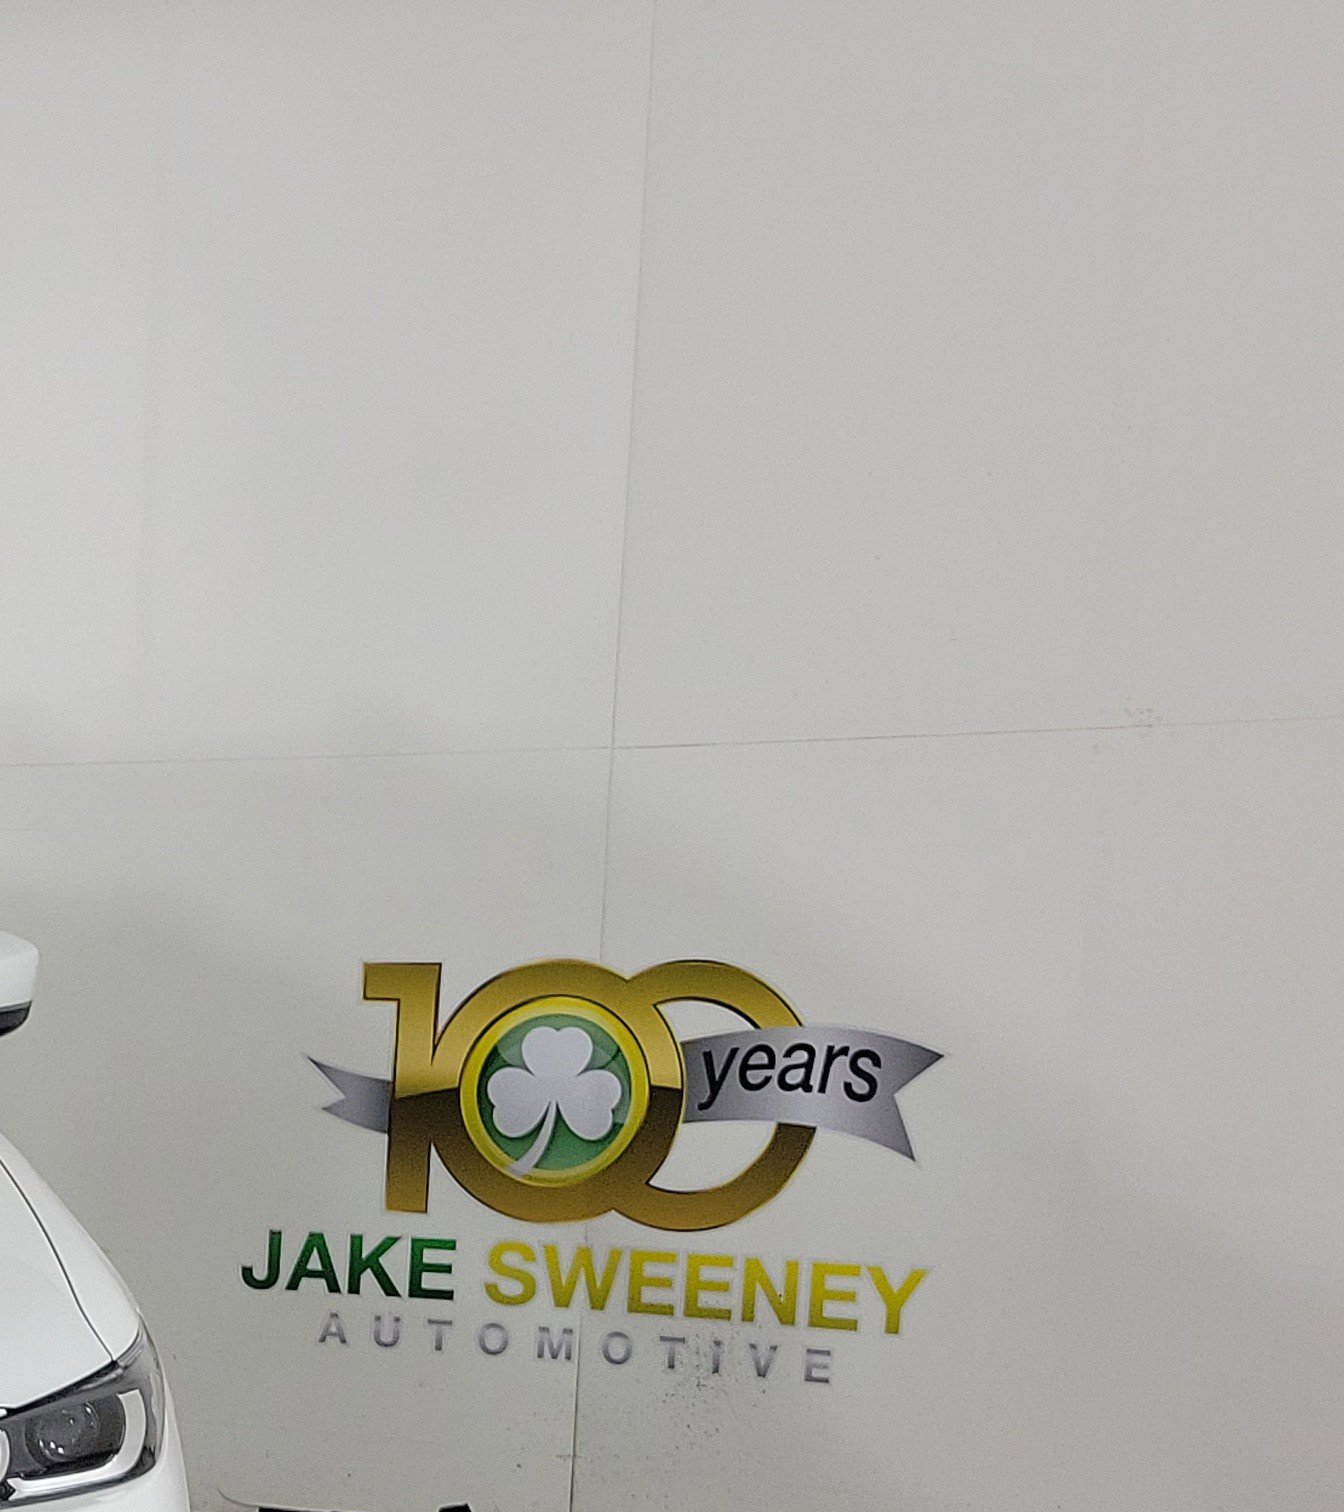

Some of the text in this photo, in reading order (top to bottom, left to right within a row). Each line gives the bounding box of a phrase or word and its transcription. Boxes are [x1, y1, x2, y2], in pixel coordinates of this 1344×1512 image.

[362, 959, 883, 1232] 100 years
[241, 1230, 926, 1335] JAKE SWEENEY
[317, 1312, 831, 1385] AUTOMOTIVE
